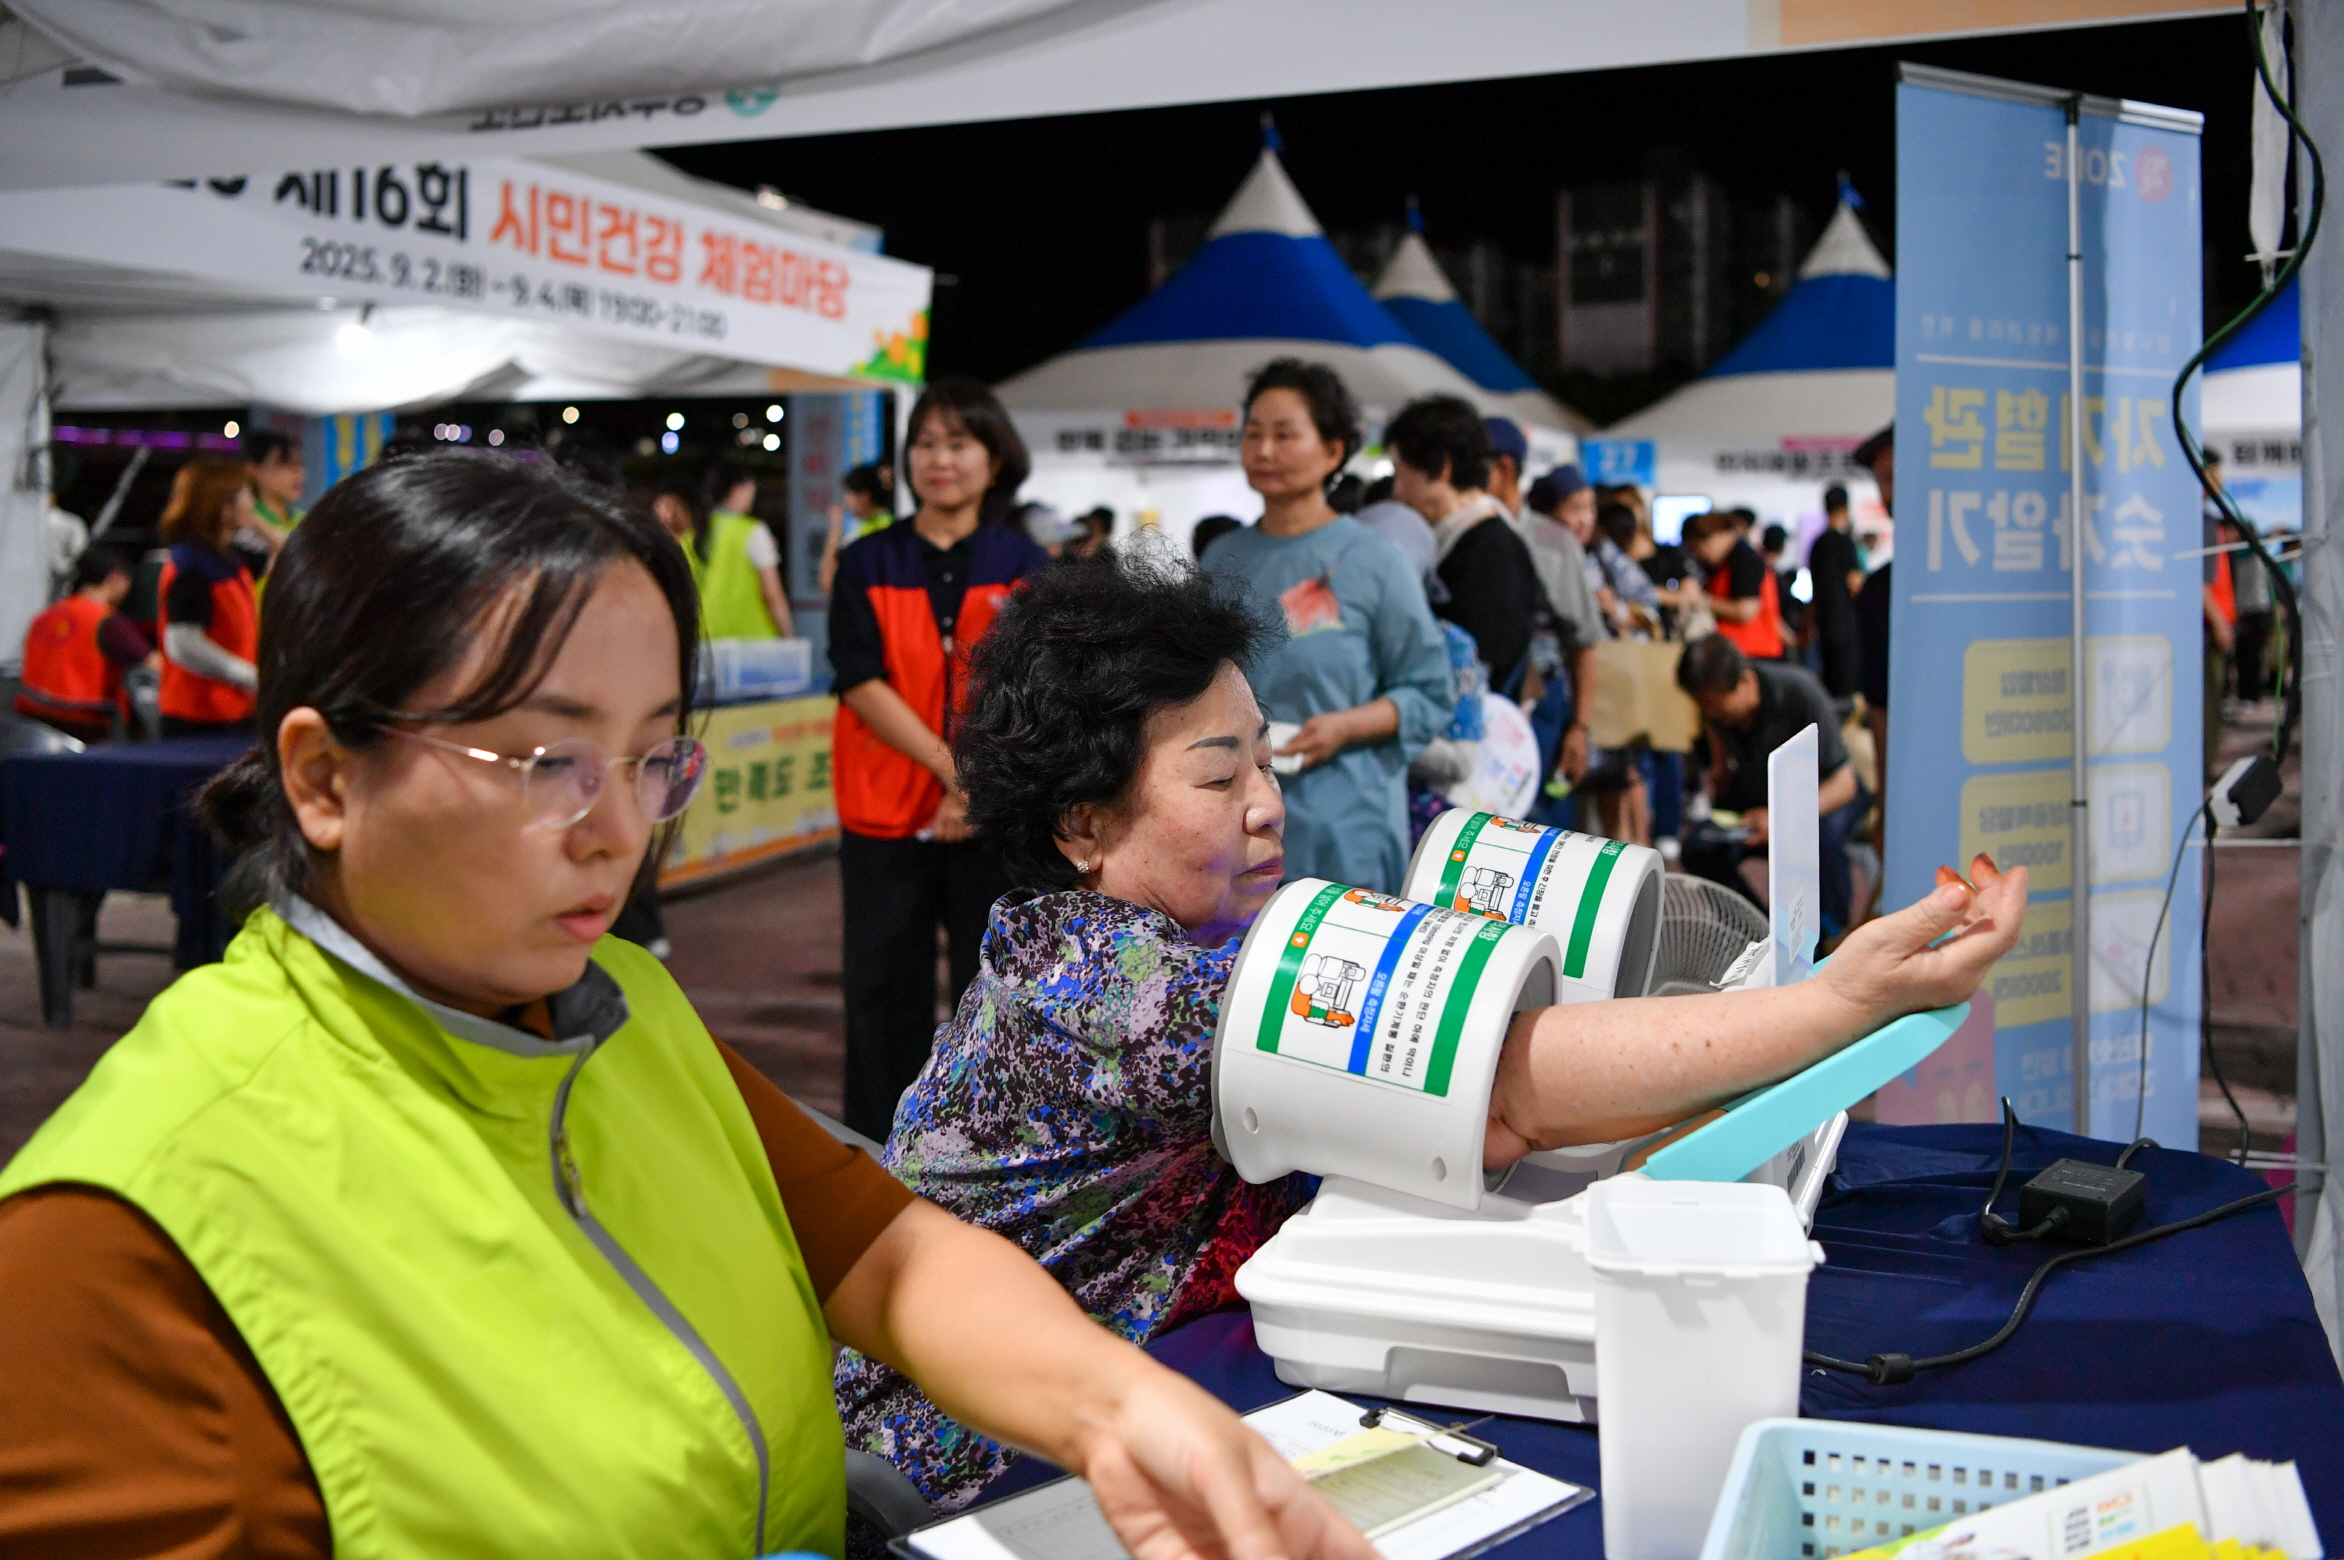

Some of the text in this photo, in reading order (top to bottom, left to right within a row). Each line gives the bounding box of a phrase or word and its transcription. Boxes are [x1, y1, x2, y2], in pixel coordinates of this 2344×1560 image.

[489, 178, 685, 284] 시민건강
[697, 228, 850, 320] 체험마당
[1457, 830, 1476, 849] 주세요
[1518, 880, 1532, 900] 오른팔
[1534, 882, 1548, 903] 긴장을
[1299, 906, 1324, 932] 주세요
[1530, 903, 1541, 918] 풀고
[1411, 946, 1429, 970] 이상일
[1437, 948, 1451, 964] 없이
[1403, 971, 1419, 989] 때는
[1422, 965, 1444, 999] 측정자의
[1358, 971, 1389, 1034] 오른팔 측정자세
[1416, 1001, 1430, 1021] 판단
[1409, 1023, 1423, 1044] 하에
[1379, 1043, 1396, 1073] 질환의
[1401, 1047, 1418, 1078] 약이나
